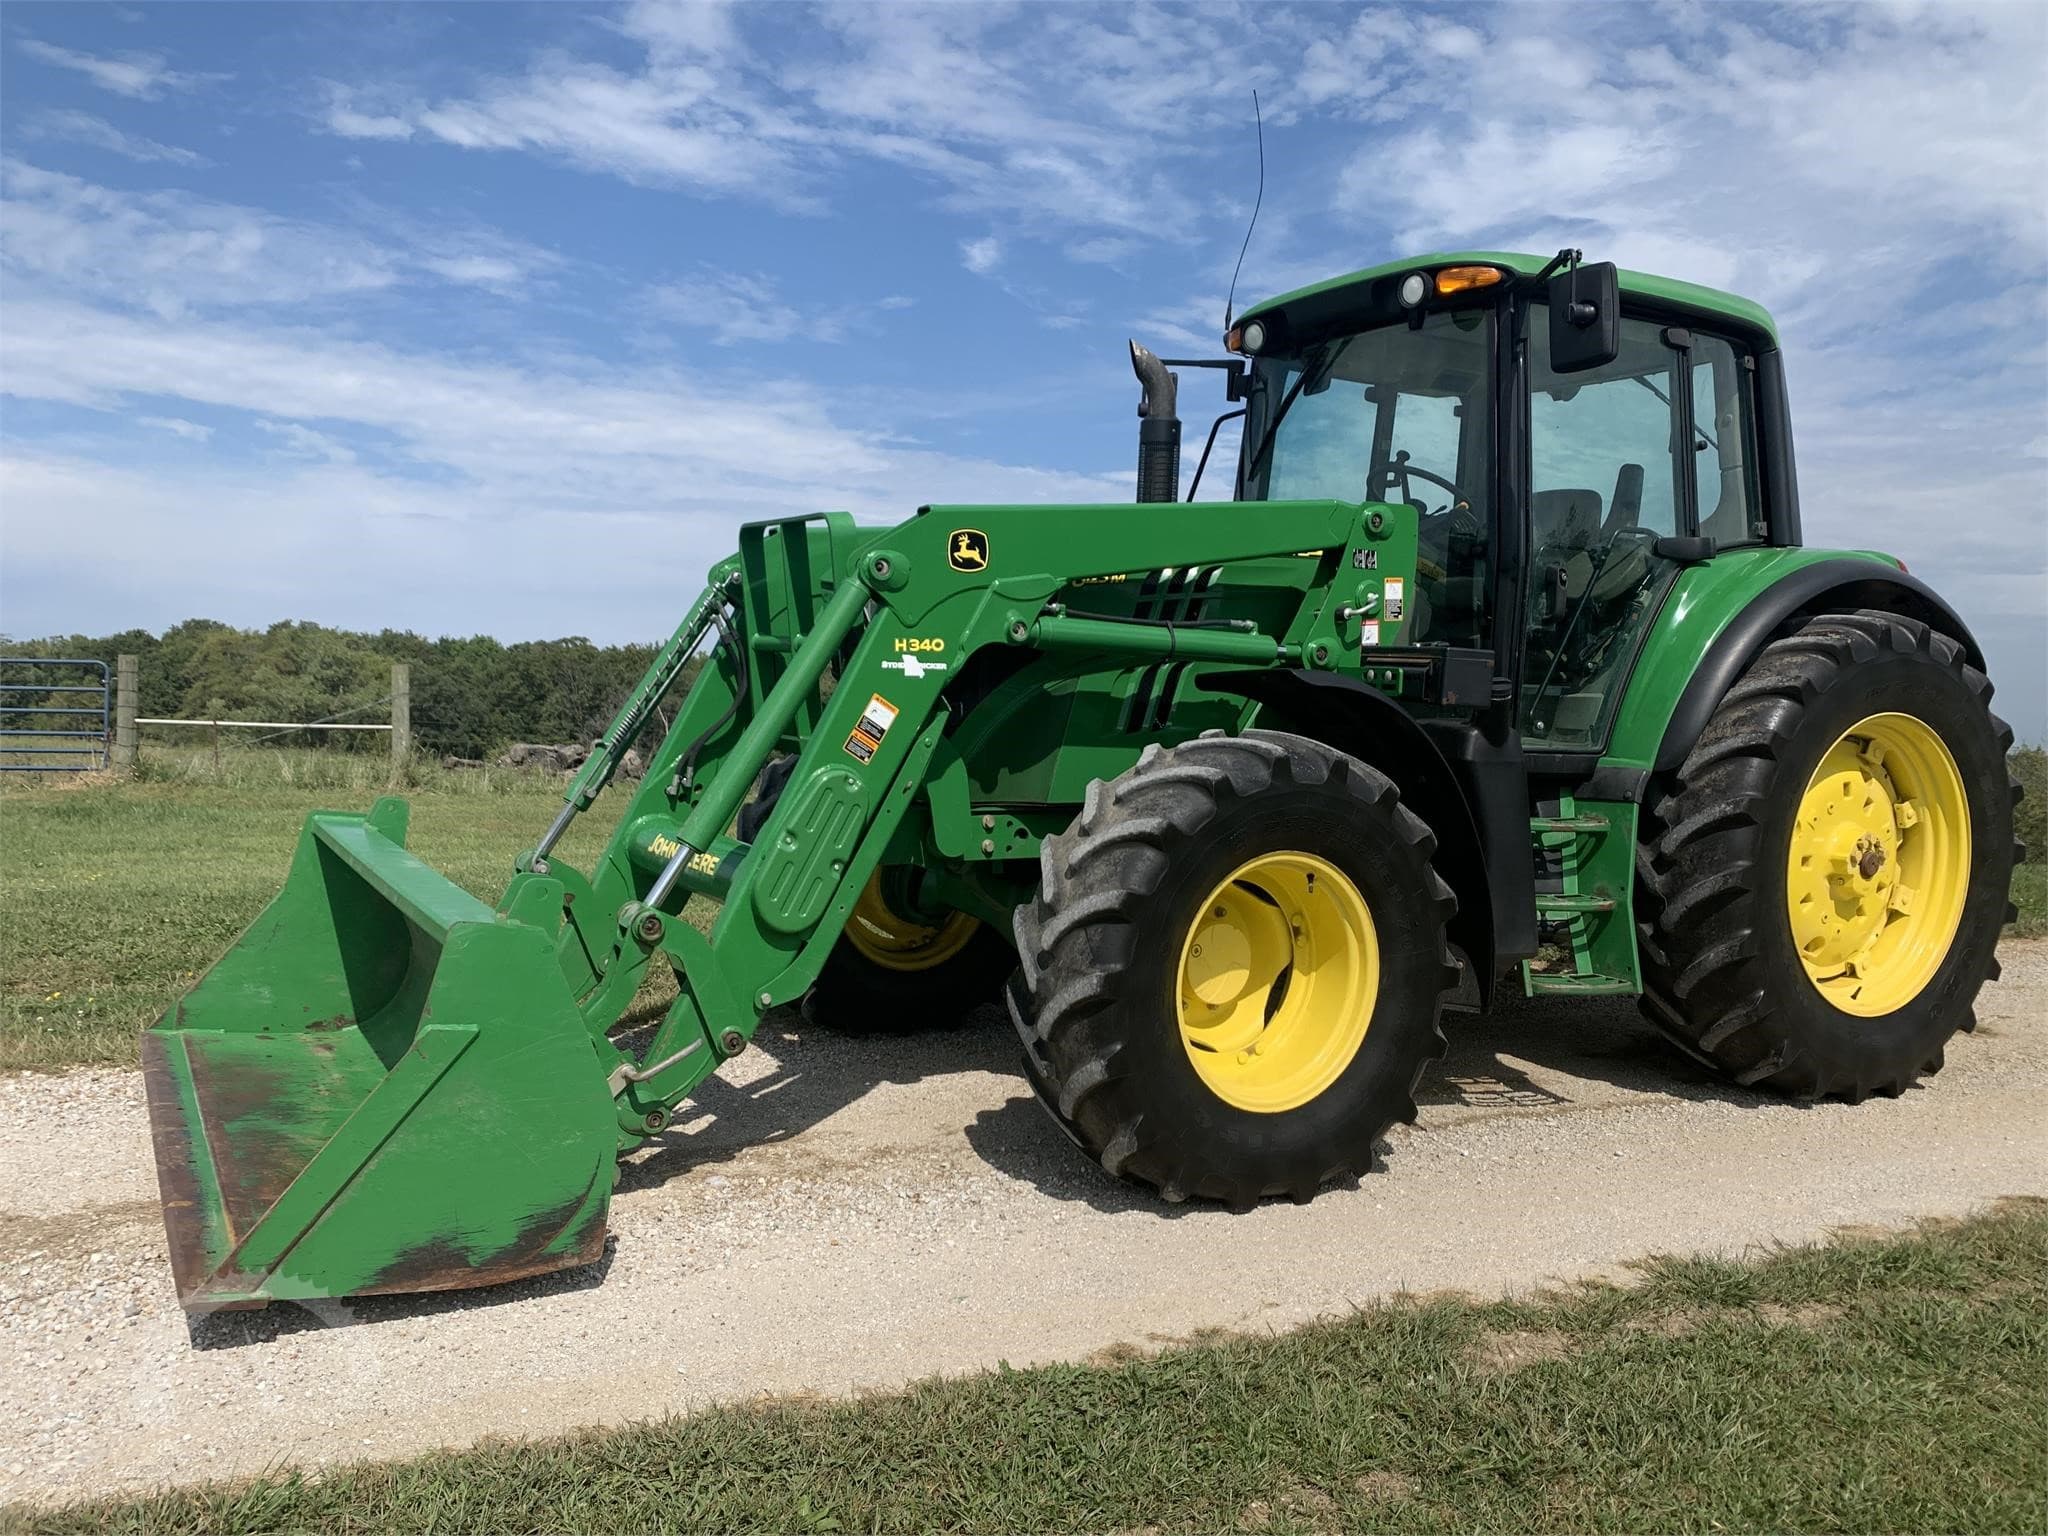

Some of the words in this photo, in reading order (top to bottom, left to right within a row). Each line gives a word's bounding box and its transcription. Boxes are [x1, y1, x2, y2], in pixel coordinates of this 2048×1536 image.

[895, 638, 945, 652] H340
[648, 833, 681, 859] JOHN
[687, 853, 720, 876] ERE
